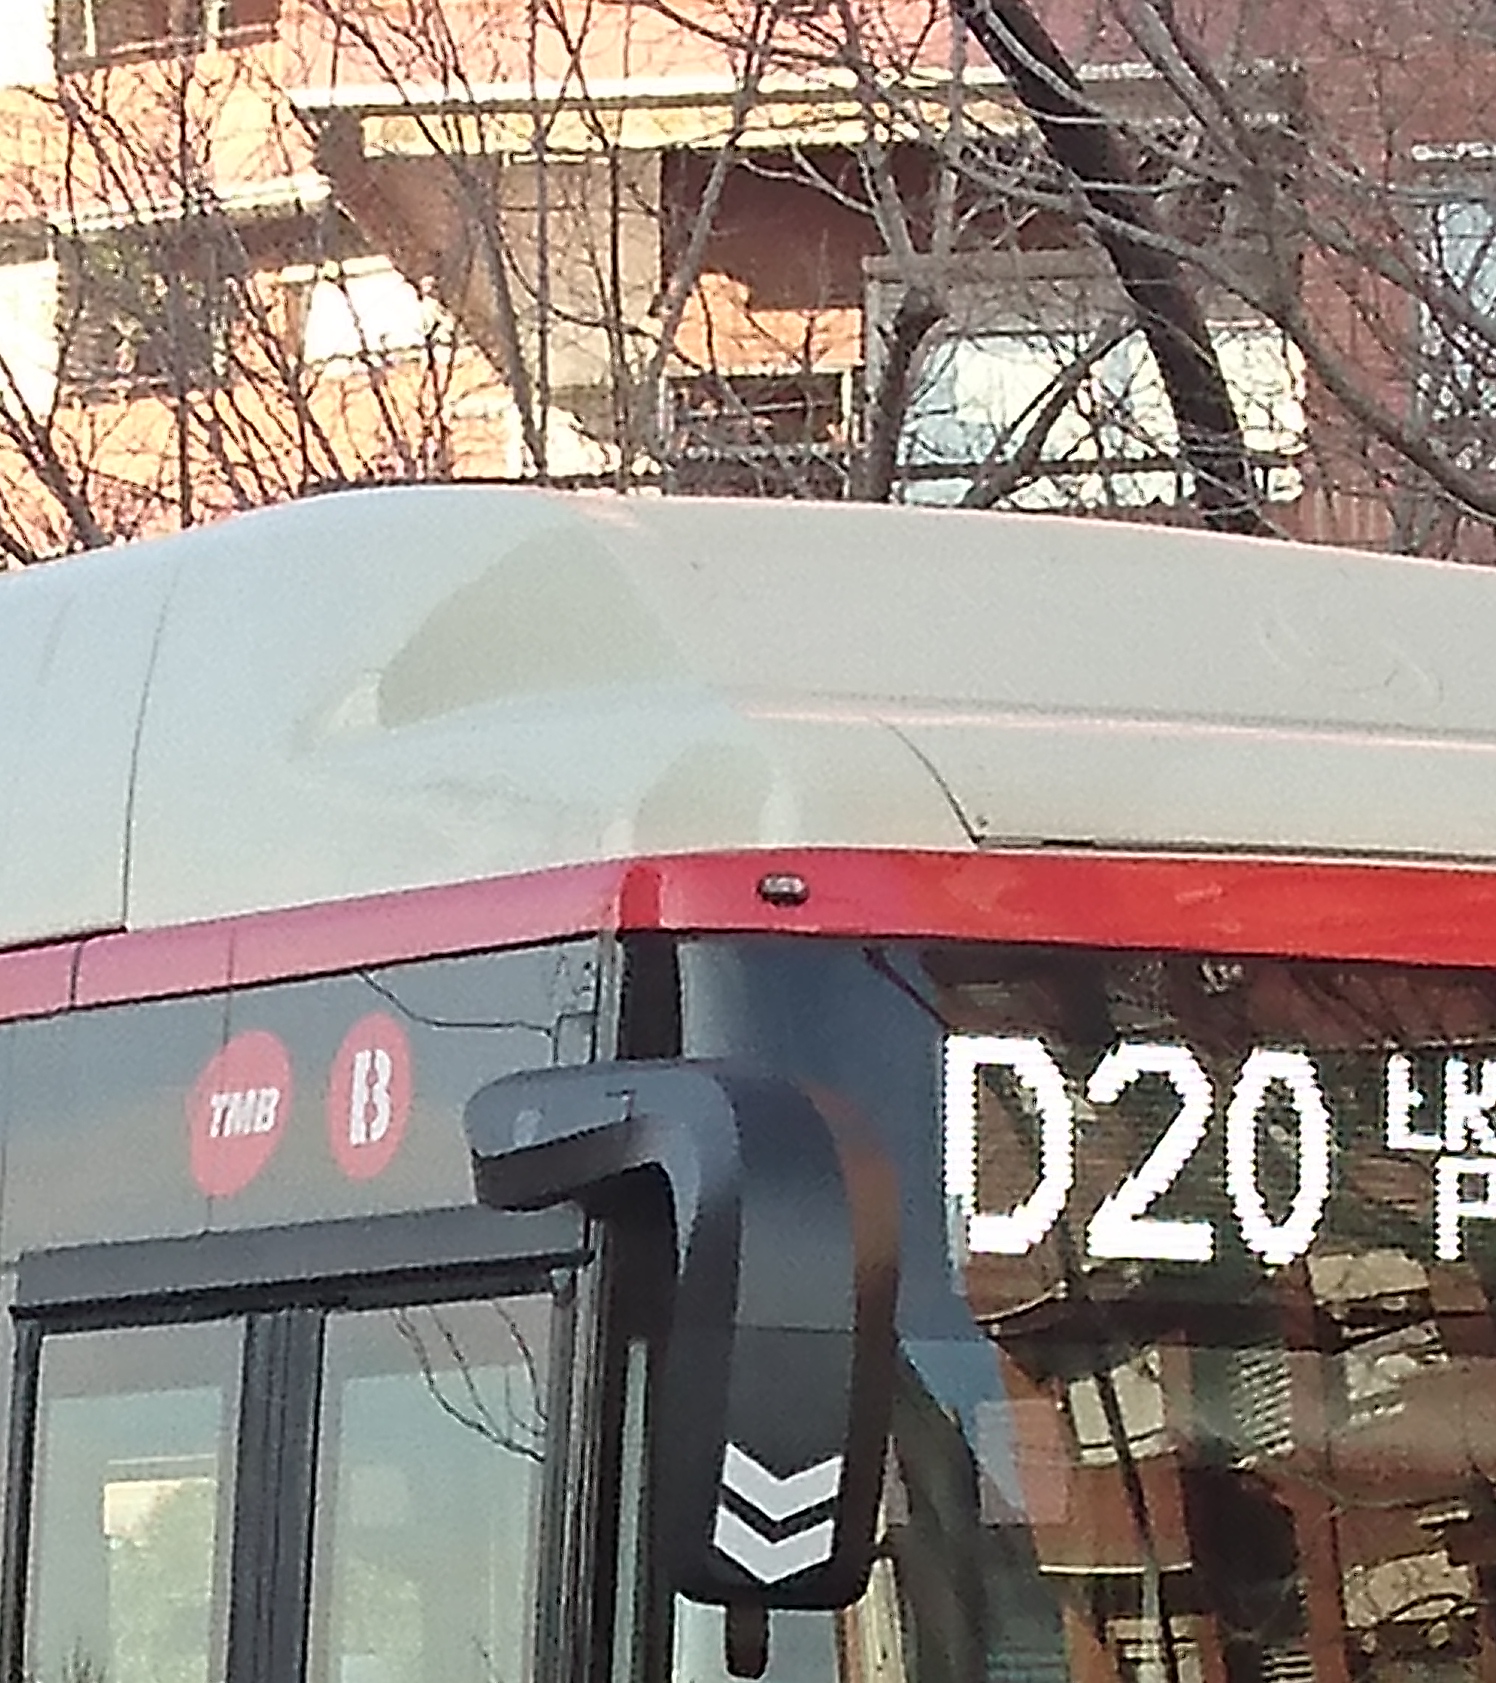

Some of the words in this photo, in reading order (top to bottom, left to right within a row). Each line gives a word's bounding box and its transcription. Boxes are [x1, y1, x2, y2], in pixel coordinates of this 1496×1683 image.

[209, 1086, 281, 1138] TMB
[348, 1048, 394, 1146] B
[941, 1033, 1336, 1265] D20
